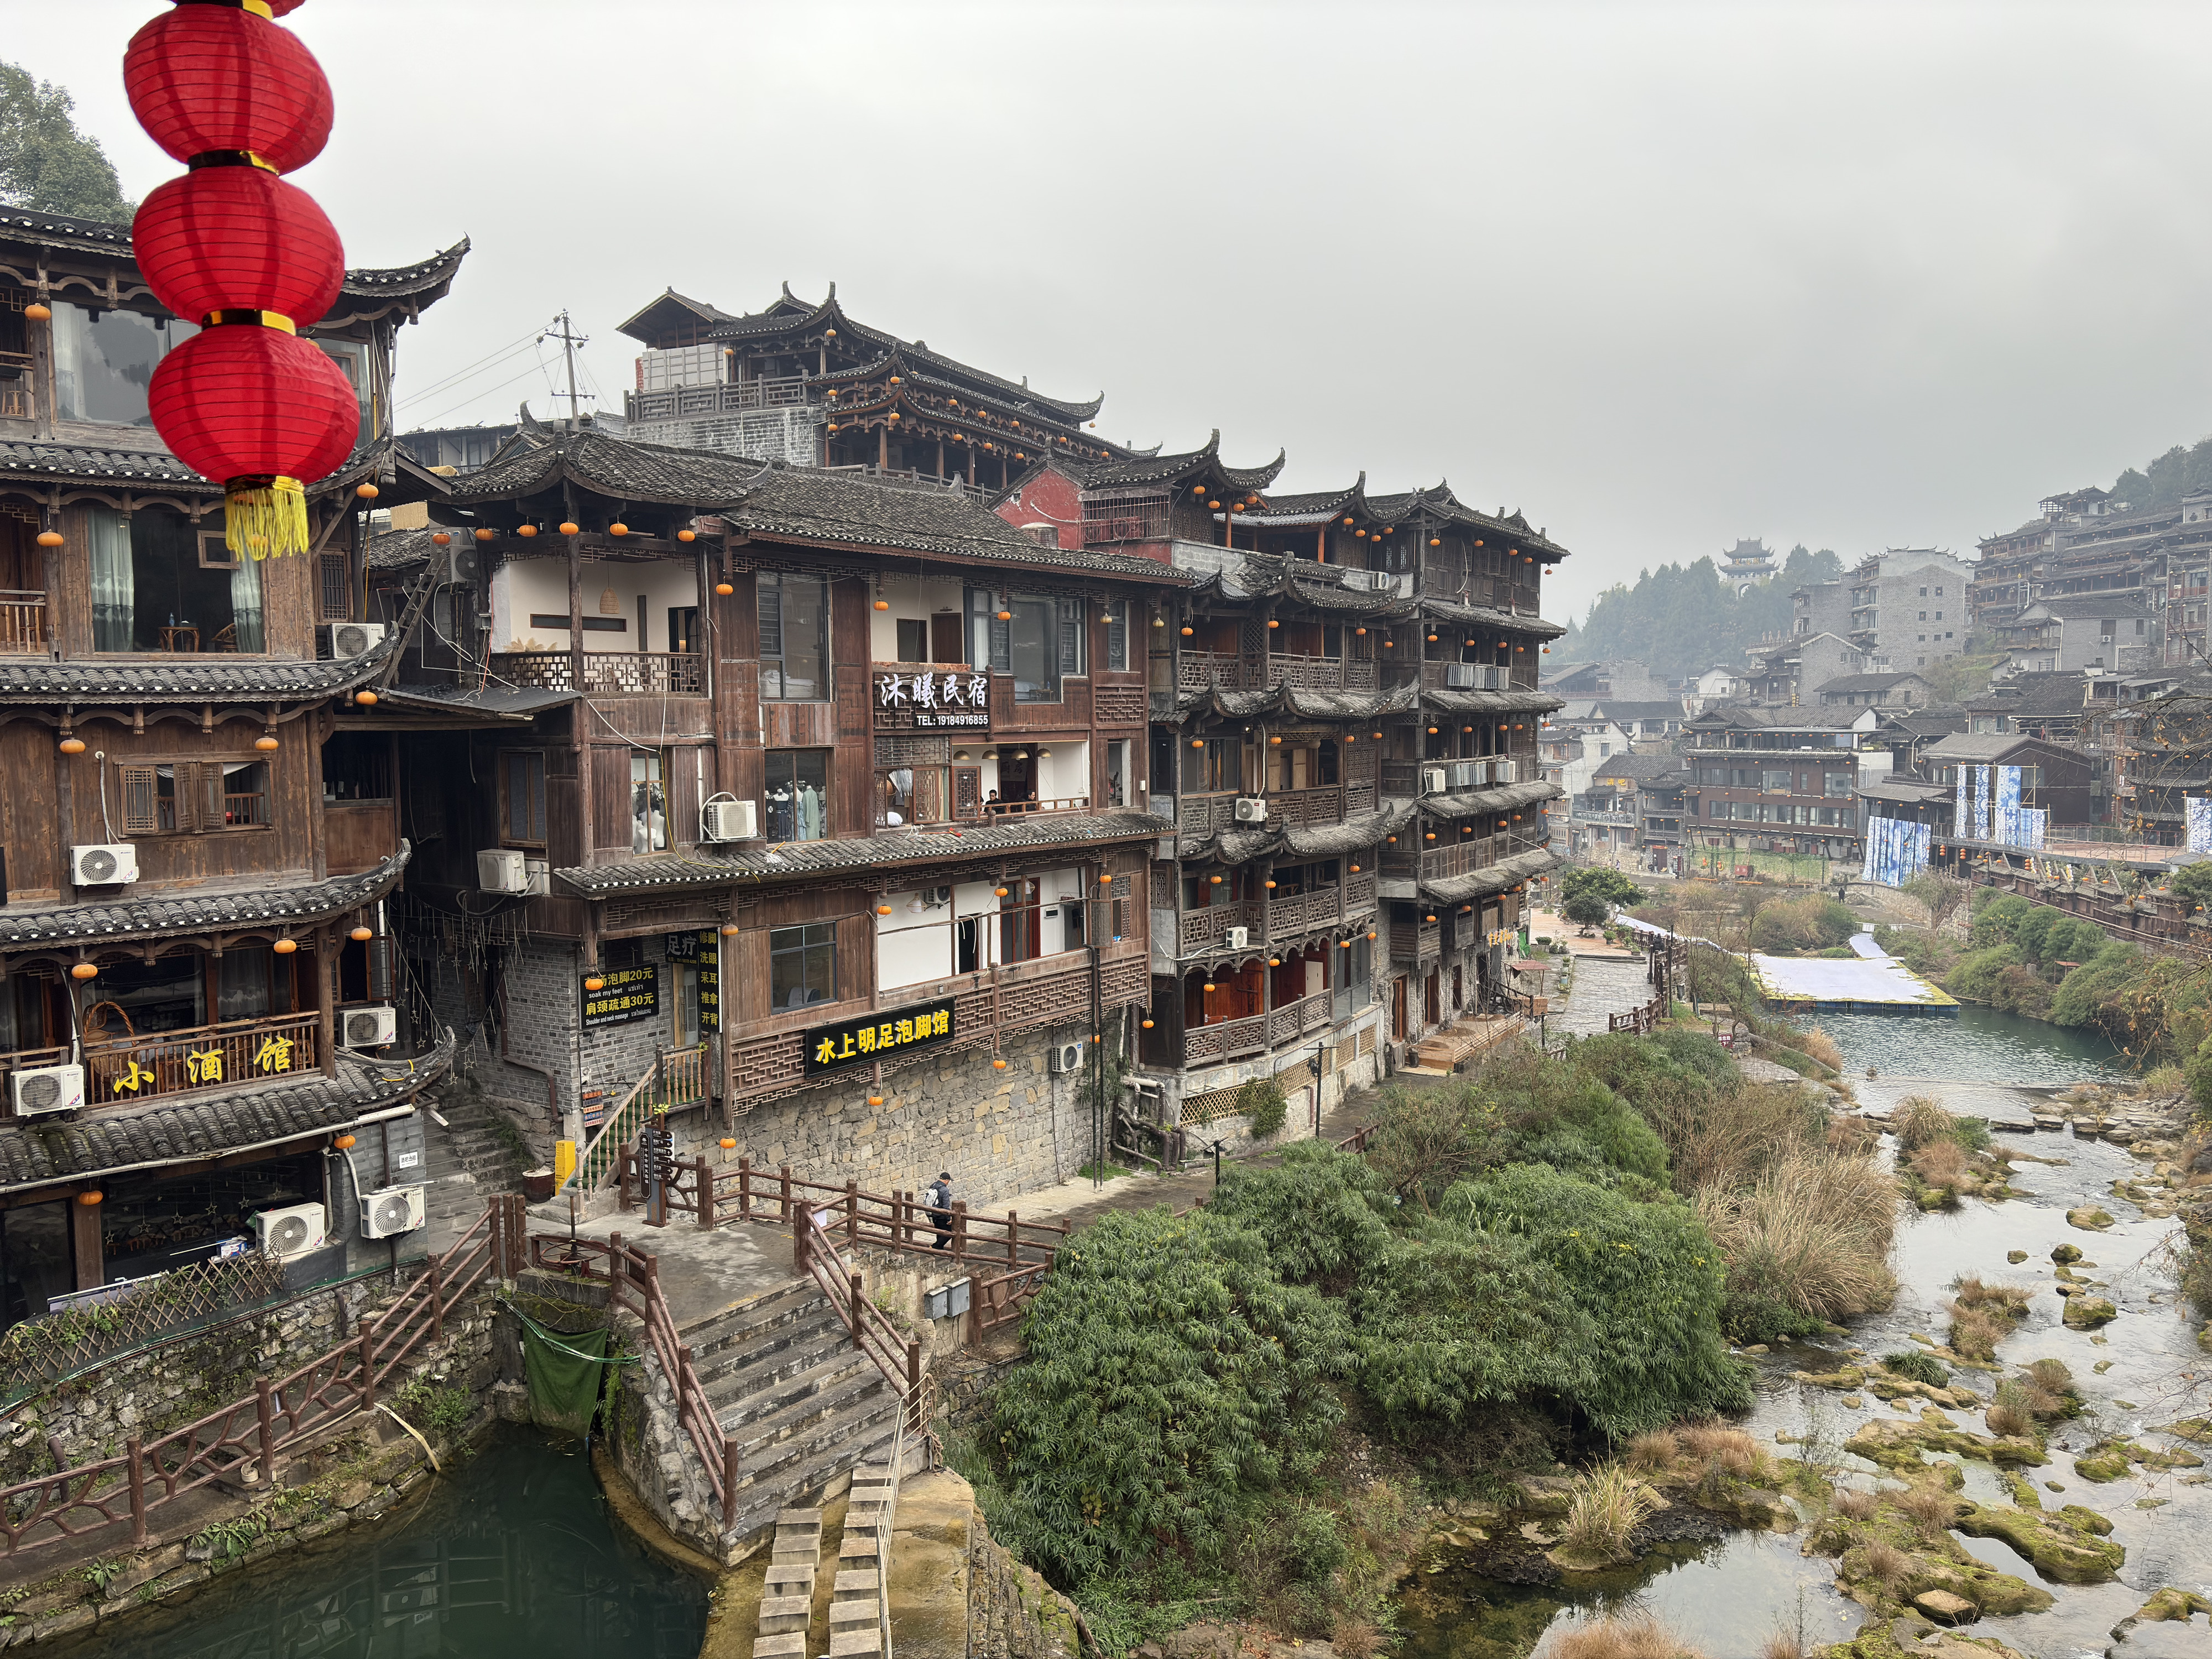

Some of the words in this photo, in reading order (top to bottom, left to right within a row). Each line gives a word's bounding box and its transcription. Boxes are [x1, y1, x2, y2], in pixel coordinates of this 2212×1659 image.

[666, 935, 697, 956] 足疗
[699, 931, 717, 945] 修脚
[700, 951, 717, 965] 洗眼
[585, 967, 653, 987] 汤泡脚20元
[700, 972, 718, 985] 采耳
[588, 990, 601, 999] soak
[701, 991, 718, 1005] 推拿
[586, 993, 654, 1016] 肩颈疏通30元
[701, 1011, 718, 1026] 开背
[815, 1009, 949, 1064] 水上明足泡脚馆
[113, 1036, 295, 1093] 小酒馆
